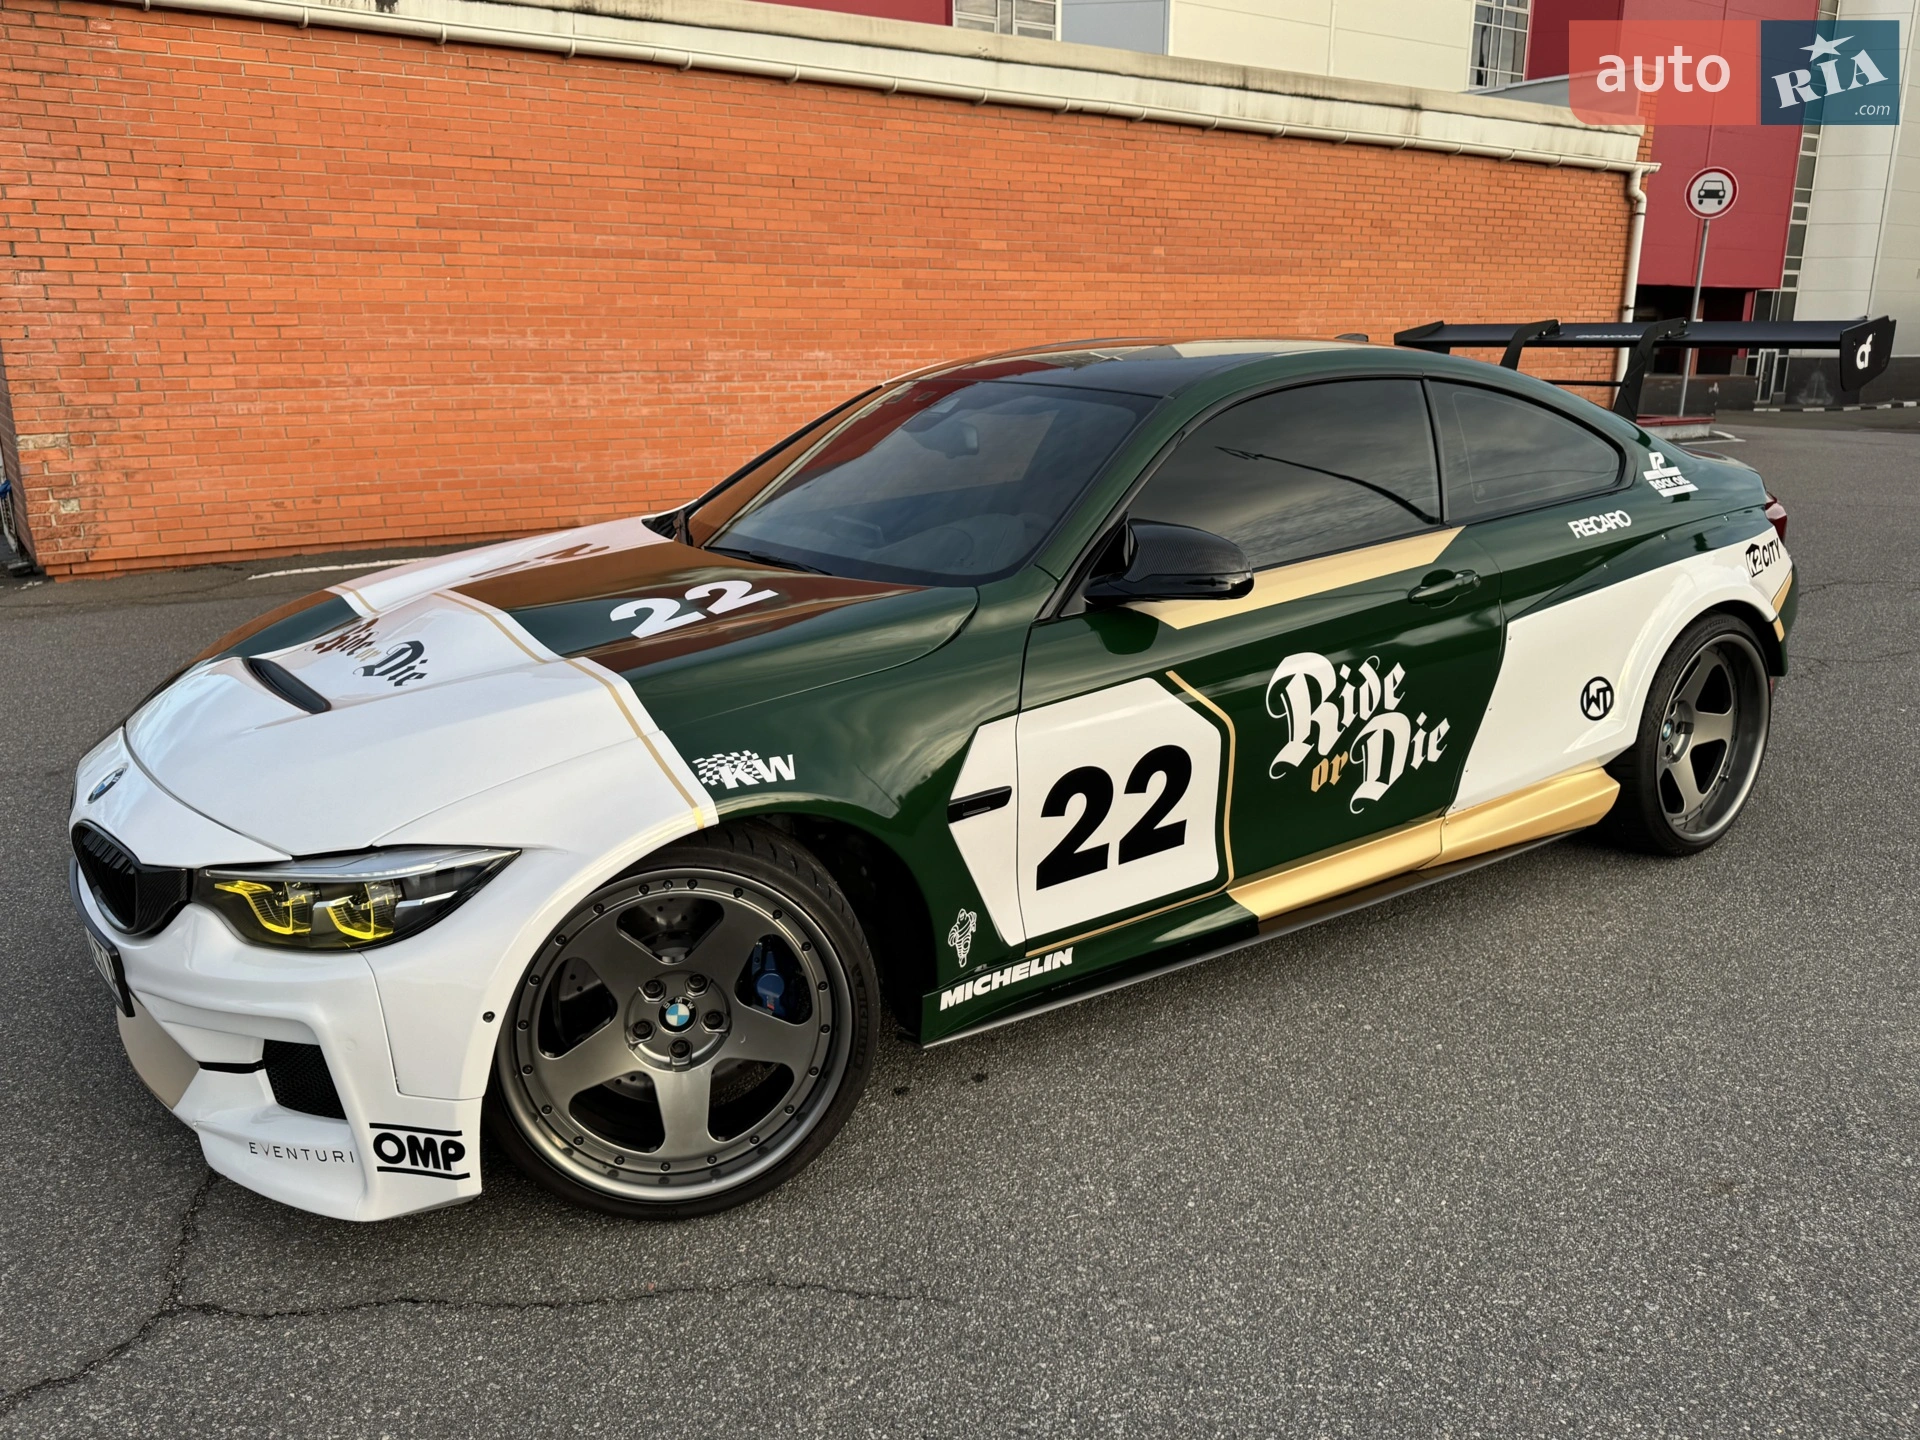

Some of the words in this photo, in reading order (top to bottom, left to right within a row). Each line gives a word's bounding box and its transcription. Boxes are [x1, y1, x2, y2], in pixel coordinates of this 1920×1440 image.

[1567, 509, 1632, 539] RECARO
[1762, 537, 1781, 567] CITY
[609, 580, 780, 639] 22
[352, 640, 429, 688] Die
[1265, 651, 1407, 780] Ride
[716, 753, 796, 790] KW
[1310, 750, 1349, 793] or
[1349, 711, 1449, 815] Die
[1035, 744, 1193, 892] 22
[939, 946, 1075, 1012] MICHELIN
[248, 1141, 355, 1164] EVENTURI
[373, 1131, 466, 1172] OMP
